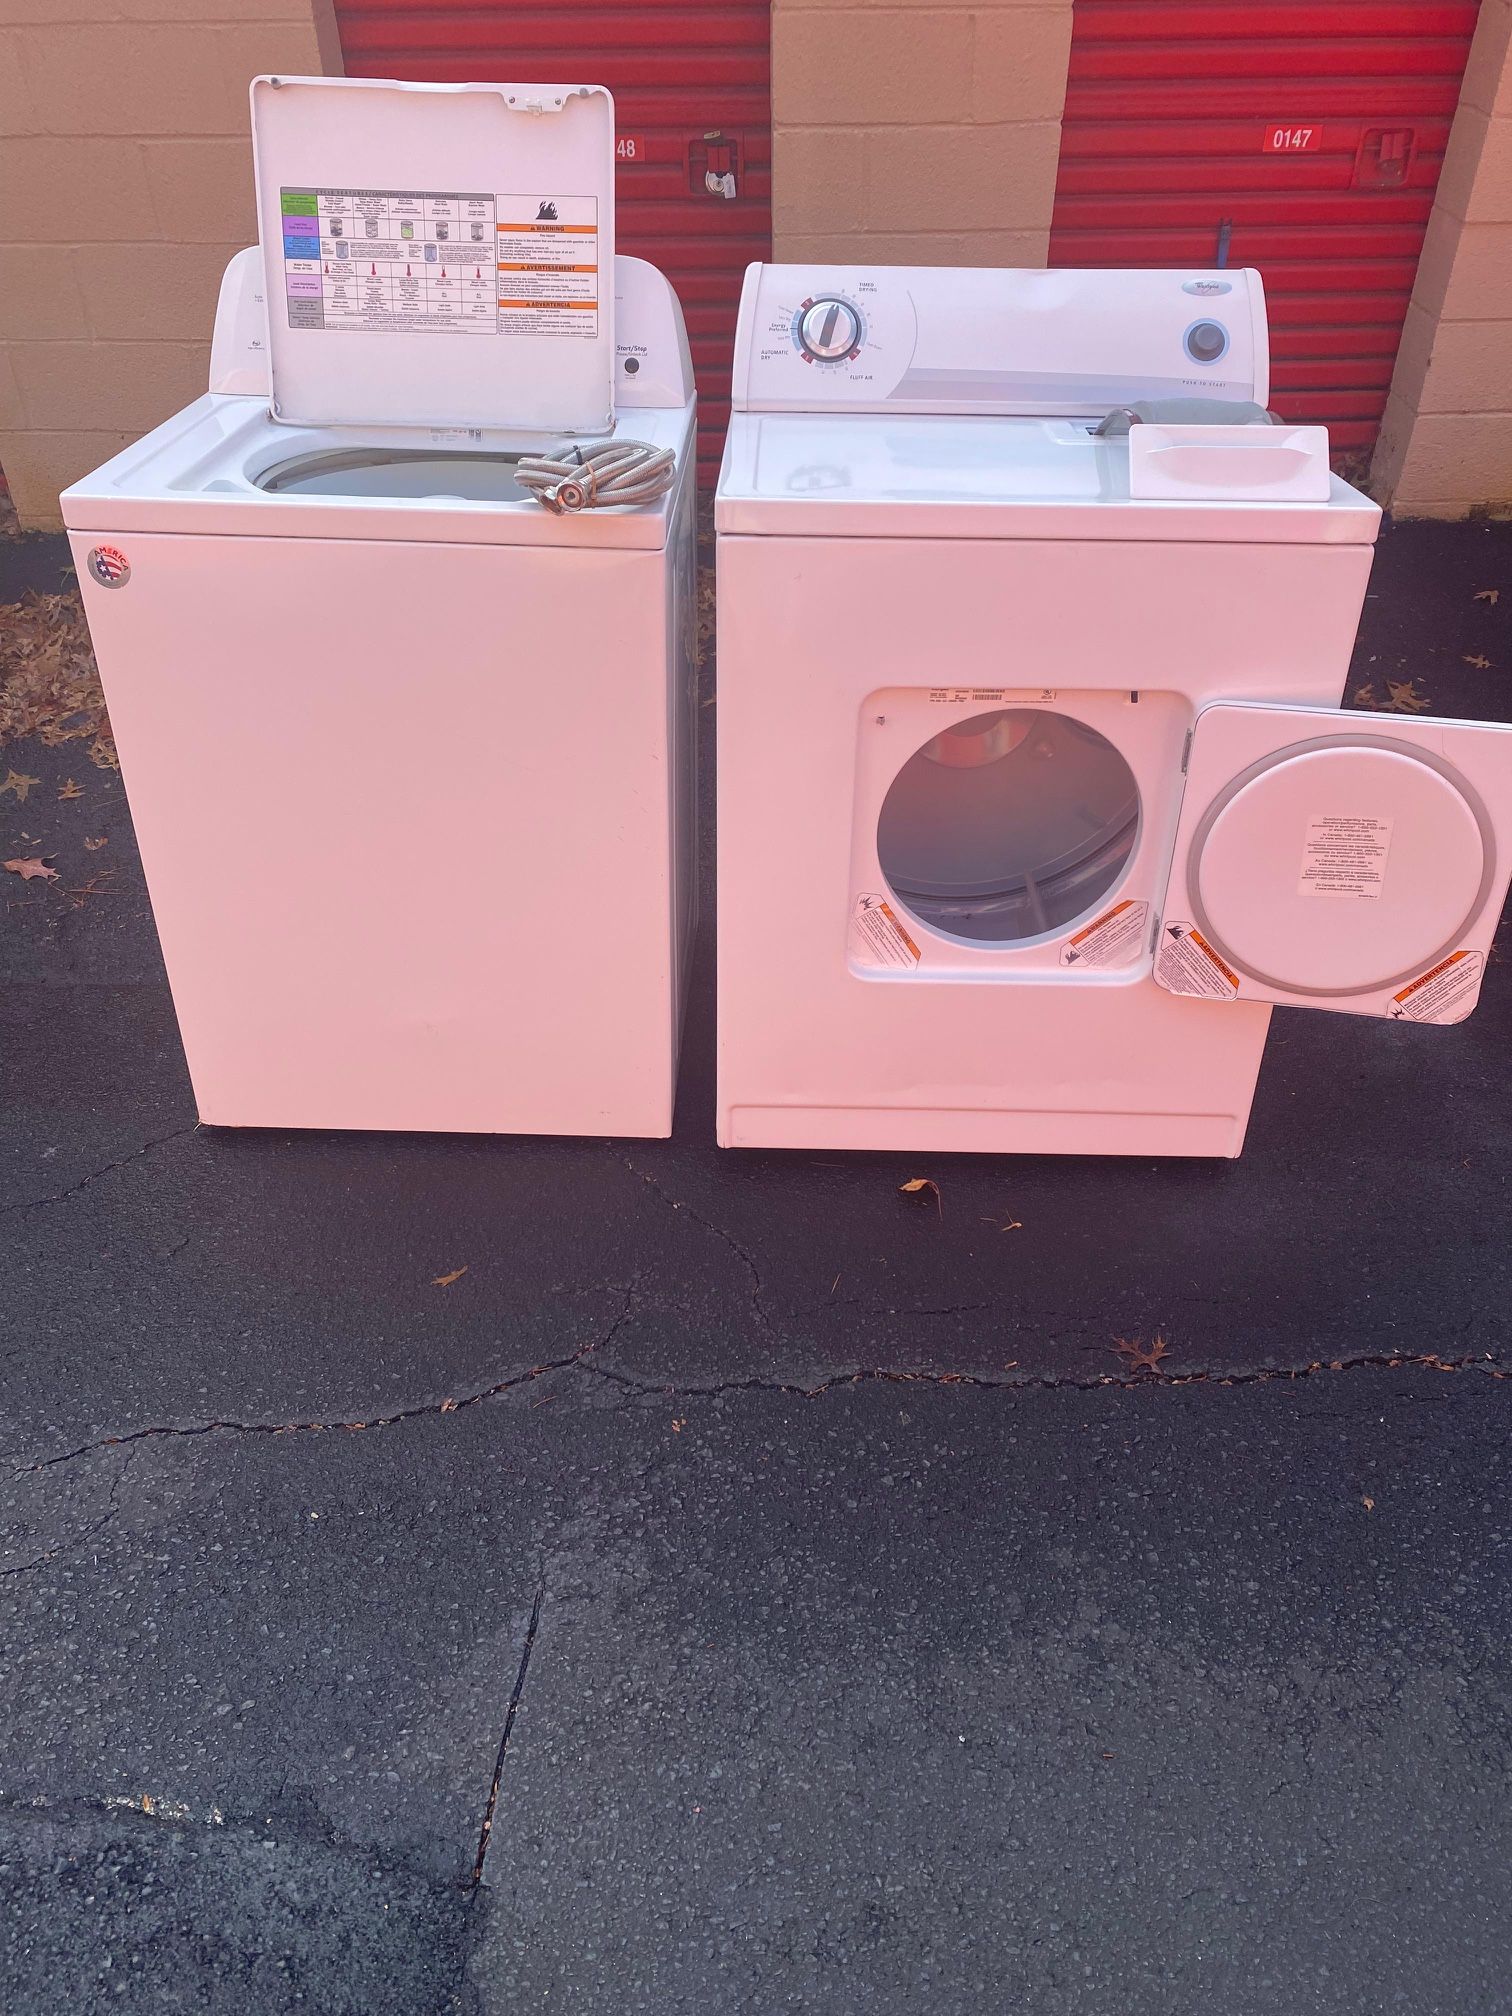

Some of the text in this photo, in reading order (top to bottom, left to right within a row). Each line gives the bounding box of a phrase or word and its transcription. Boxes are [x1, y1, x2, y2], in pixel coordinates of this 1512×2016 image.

[1273, 129, 1313, 148] 0147
[617, 139, 635, 158] 48
[527, 264, 576, 272] AVERTISSEMENT
[616, 344, 648, 353] Start/Stop
[94, 547, 129, 571] AMERICA
[1202, 944, 1234, 979] ADVERTENCIA
[1412, 959, 1455, 990] ADVERTENCIA
